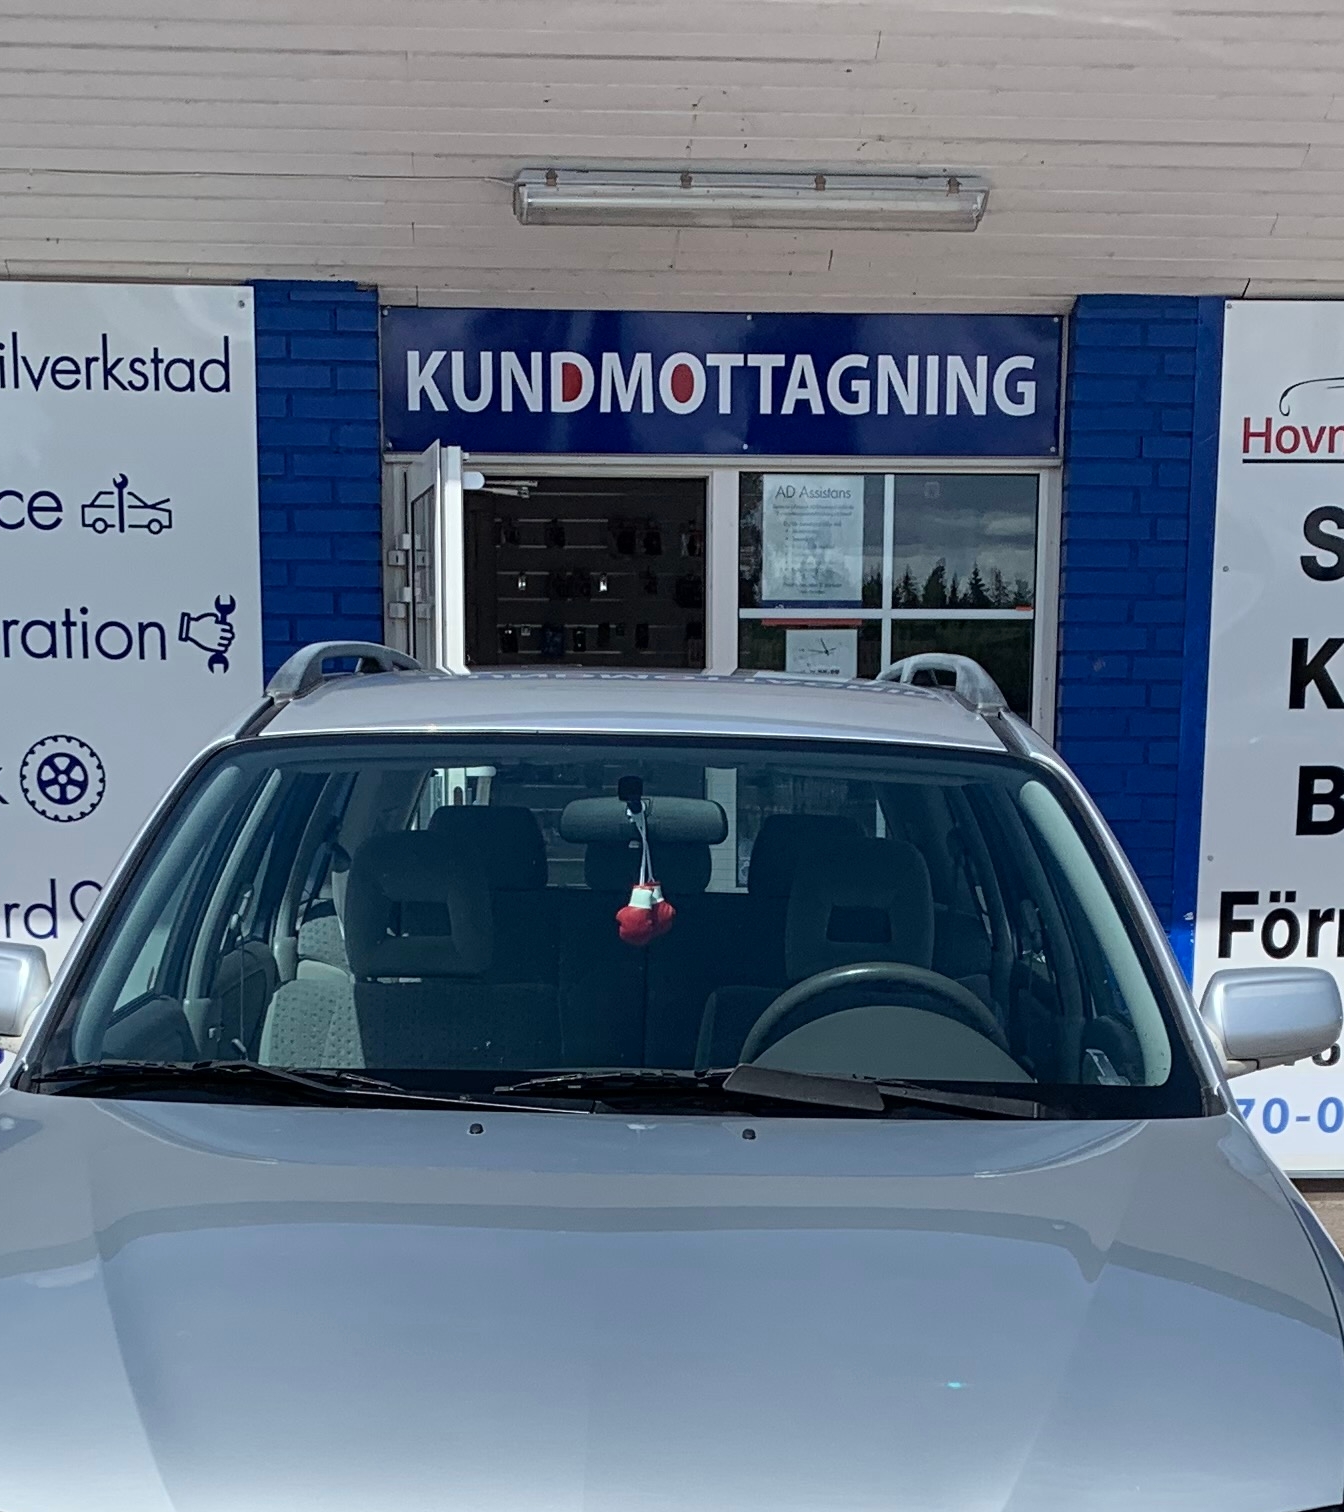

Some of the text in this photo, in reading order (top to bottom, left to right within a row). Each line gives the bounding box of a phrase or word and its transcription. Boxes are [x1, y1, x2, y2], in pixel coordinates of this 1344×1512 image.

[406, 350, 1037, 417] KUNDMOTTAGNING
[775, 485, 852, 499] AD Assistans
